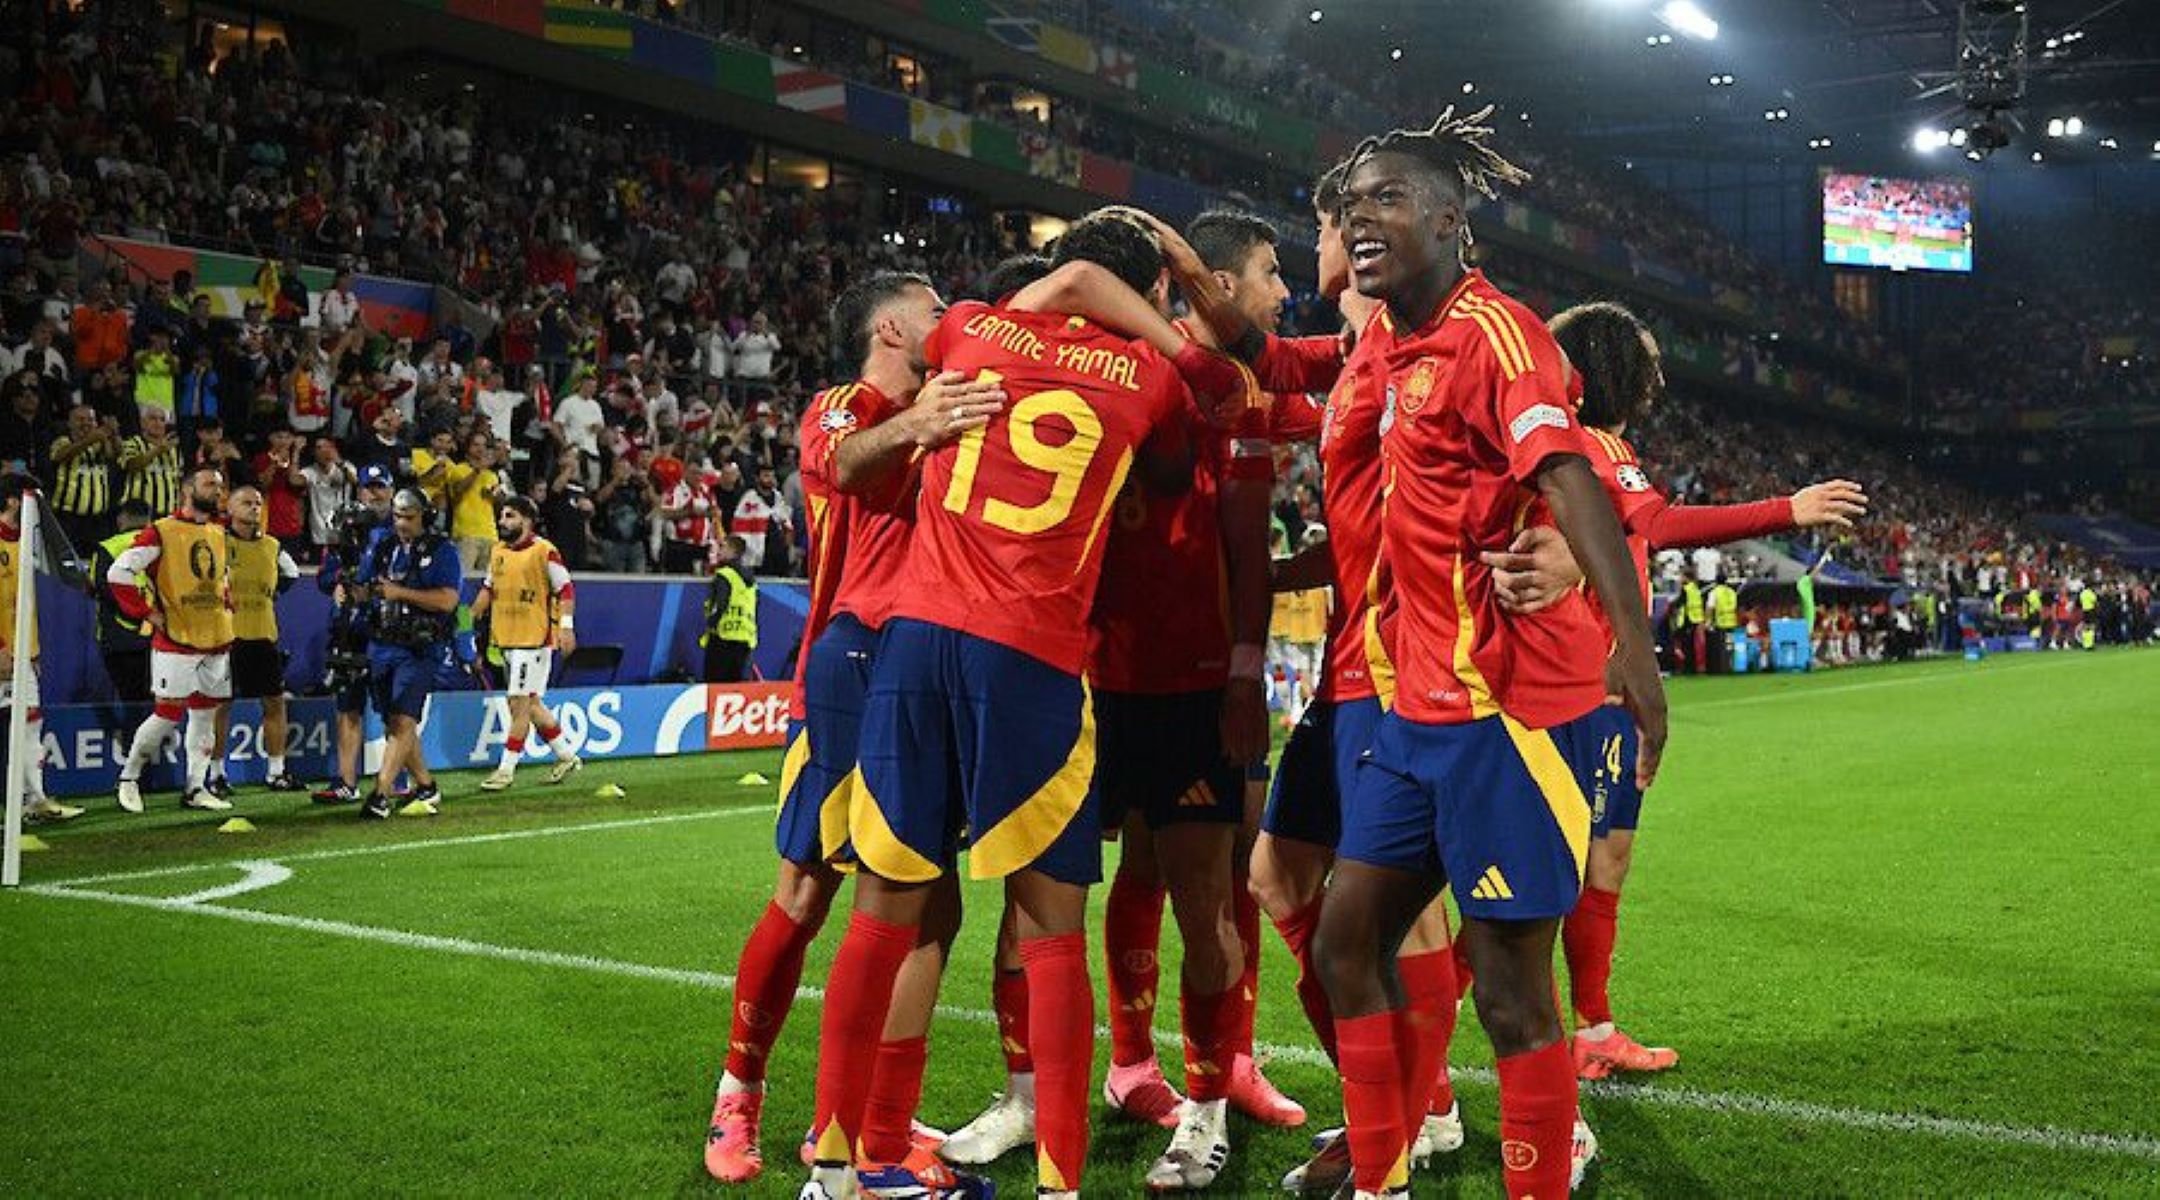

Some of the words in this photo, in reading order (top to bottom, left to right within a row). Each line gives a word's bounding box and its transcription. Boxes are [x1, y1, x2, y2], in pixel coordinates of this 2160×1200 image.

[963, 313, 1048, 361] LAMINE
[1055, 344, 1141, 391] YAMAL
[943, 368, 1103, 534] 19
[1602, 732, 1622, 784] 4
